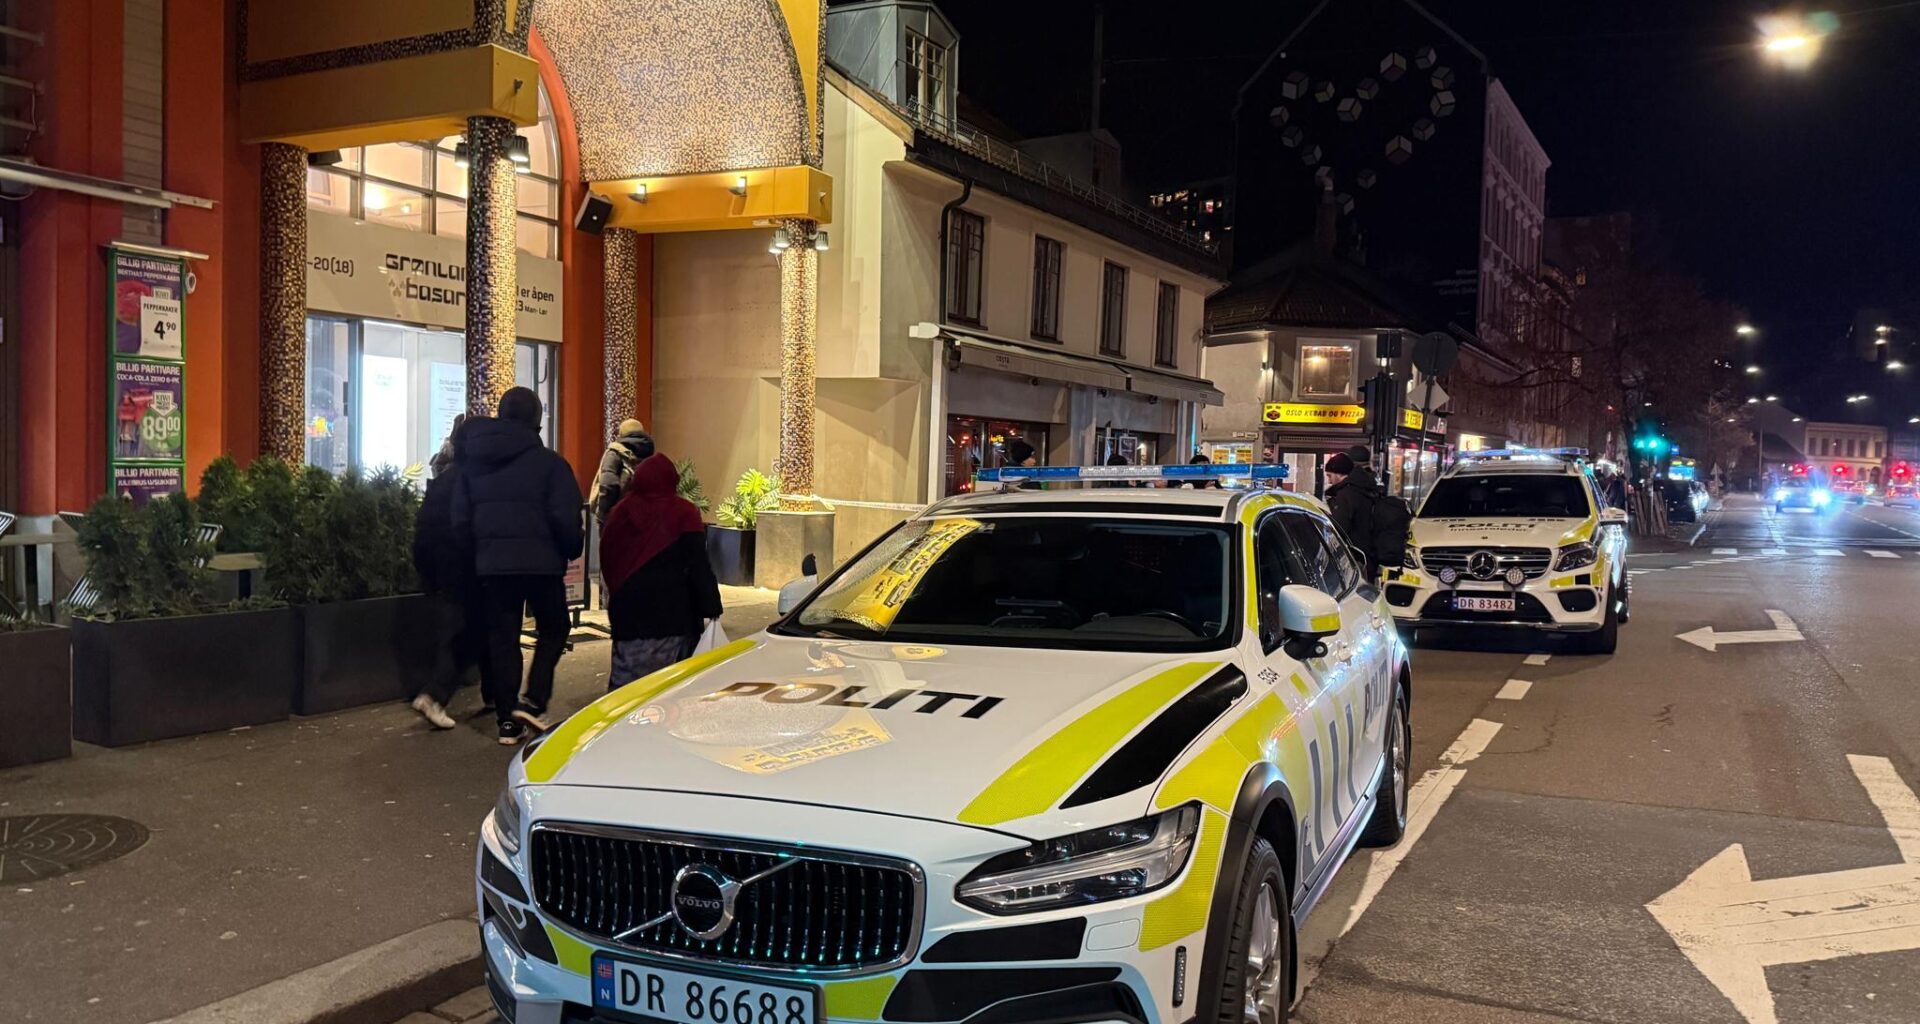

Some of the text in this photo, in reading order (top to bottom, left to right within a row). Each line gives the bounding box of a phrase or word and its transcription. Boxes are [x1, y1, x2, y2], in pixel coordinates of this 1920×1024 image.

[118, 256, 180, 273] BILLIG PARTIVARE
[521, 288, 530, 298] er
[531, 286, 554, 302] åpen
[116, 362, 180, 375] BILLIG PARTIVARE
[117, 374, 149, 382] COCA-COLA
[115, 468, 180, 478] BILLIG PARTIVARE
[1460, 598, 1474, 608] DR
[1479, 599, 1513, 609] 83482
[701, 681, 1006, 719] POLITI
[677, 896, 720, 909] VOLVO
[601, 988, 610, 999] N
[620, 968, 805, 1024] DR 86688
